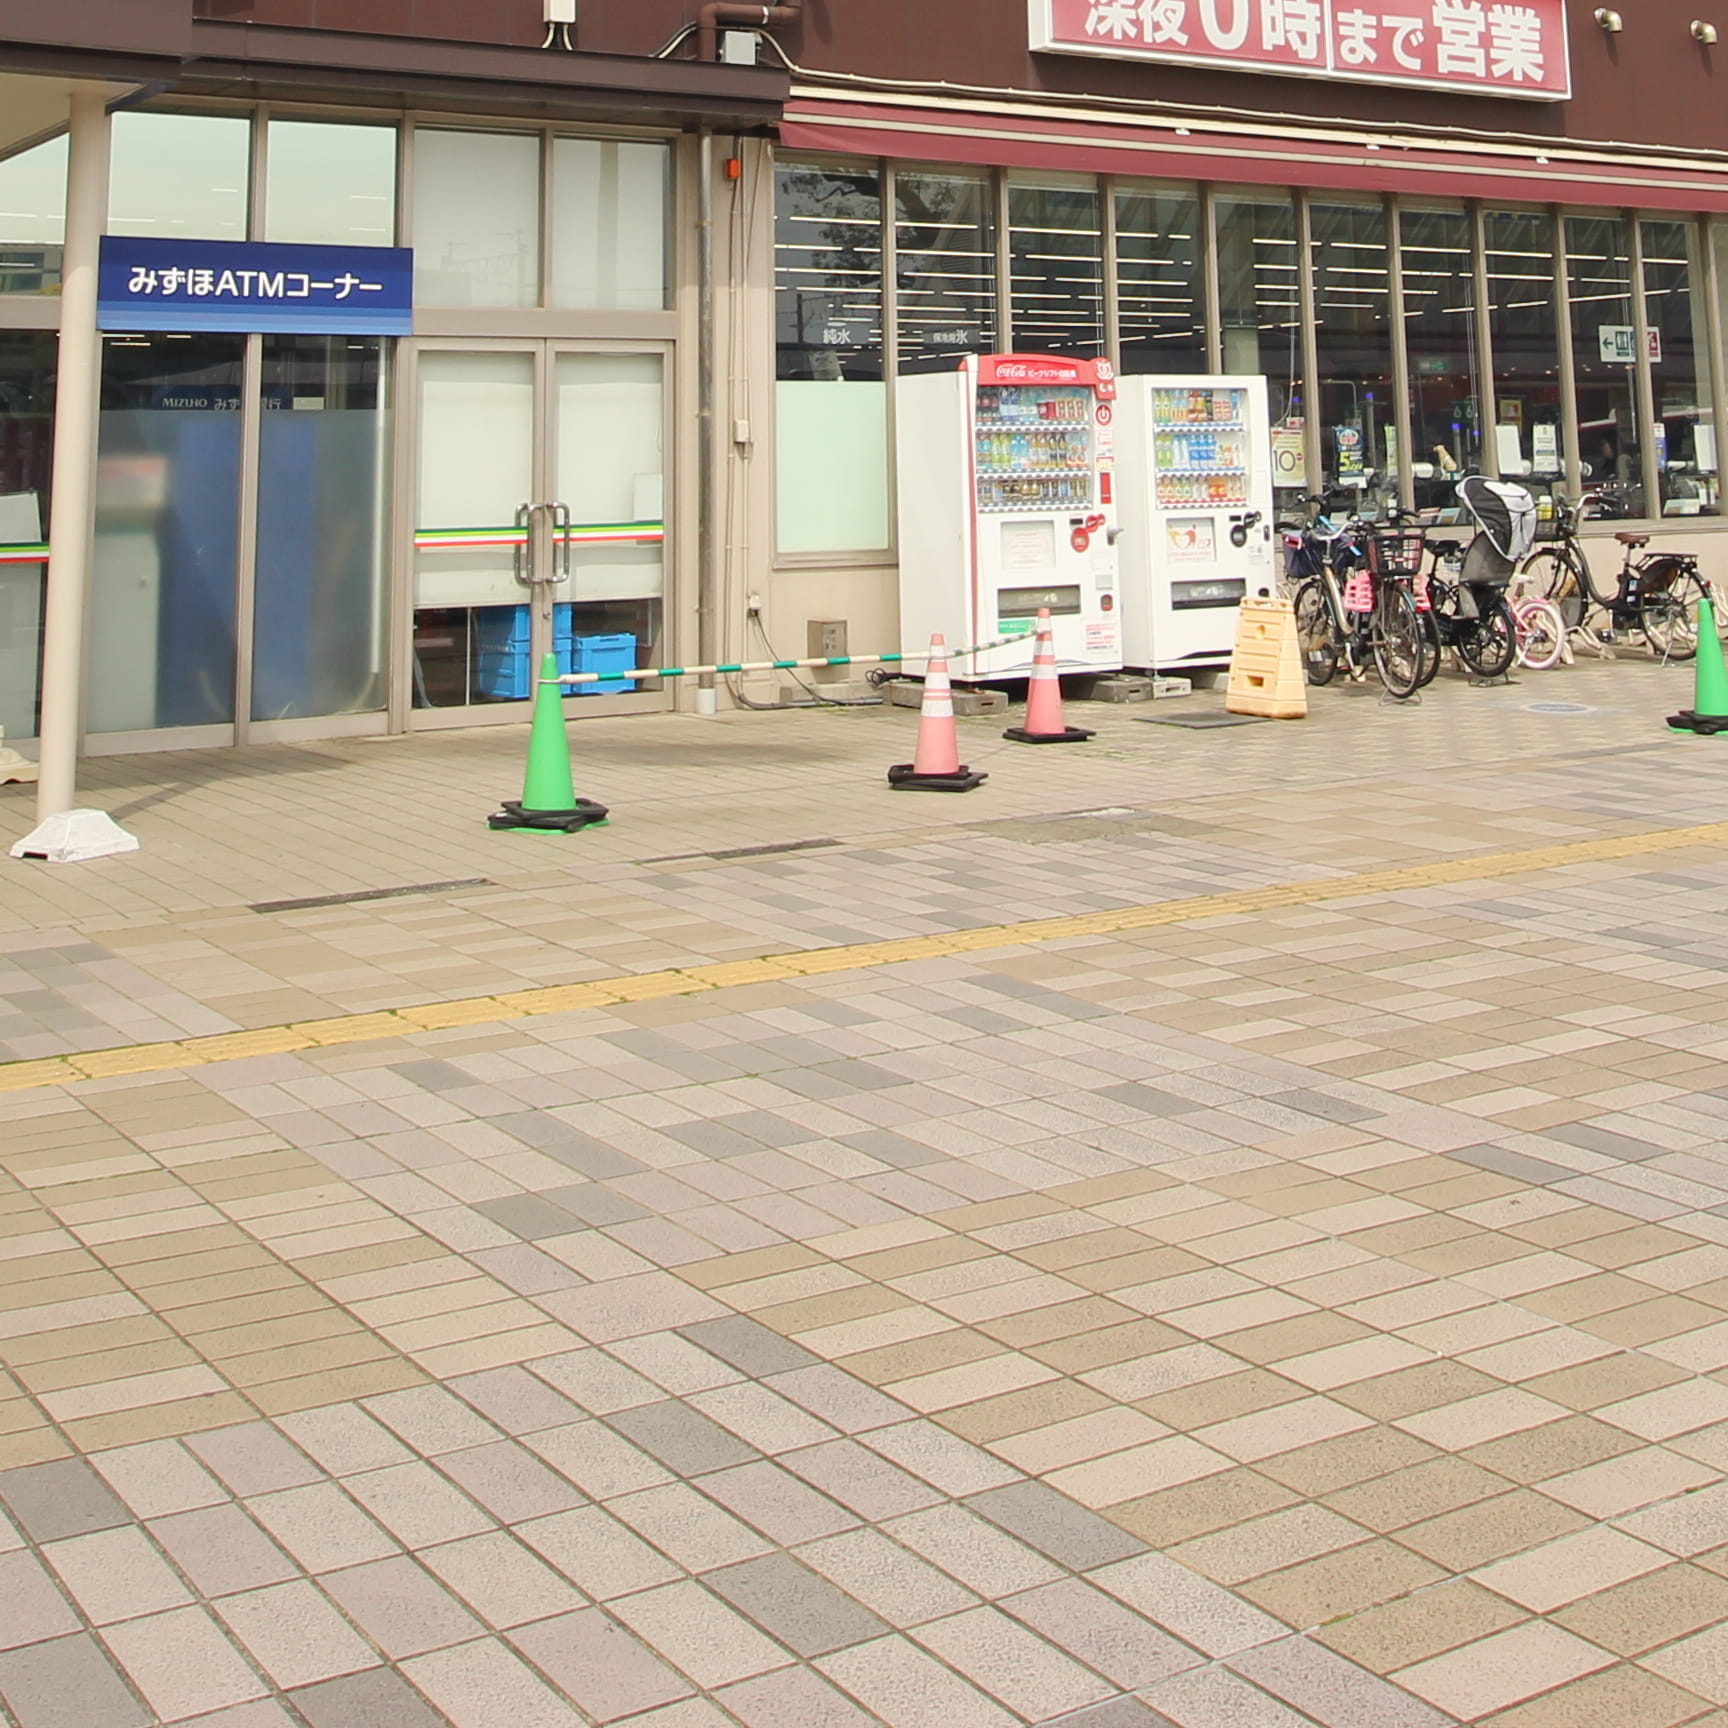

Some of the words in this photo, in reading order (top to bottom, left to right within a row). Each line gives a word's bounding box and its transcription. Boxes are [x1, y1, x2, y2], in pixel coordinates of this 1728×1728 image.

[128, 266, 383, 299] みずほATMコーナー
